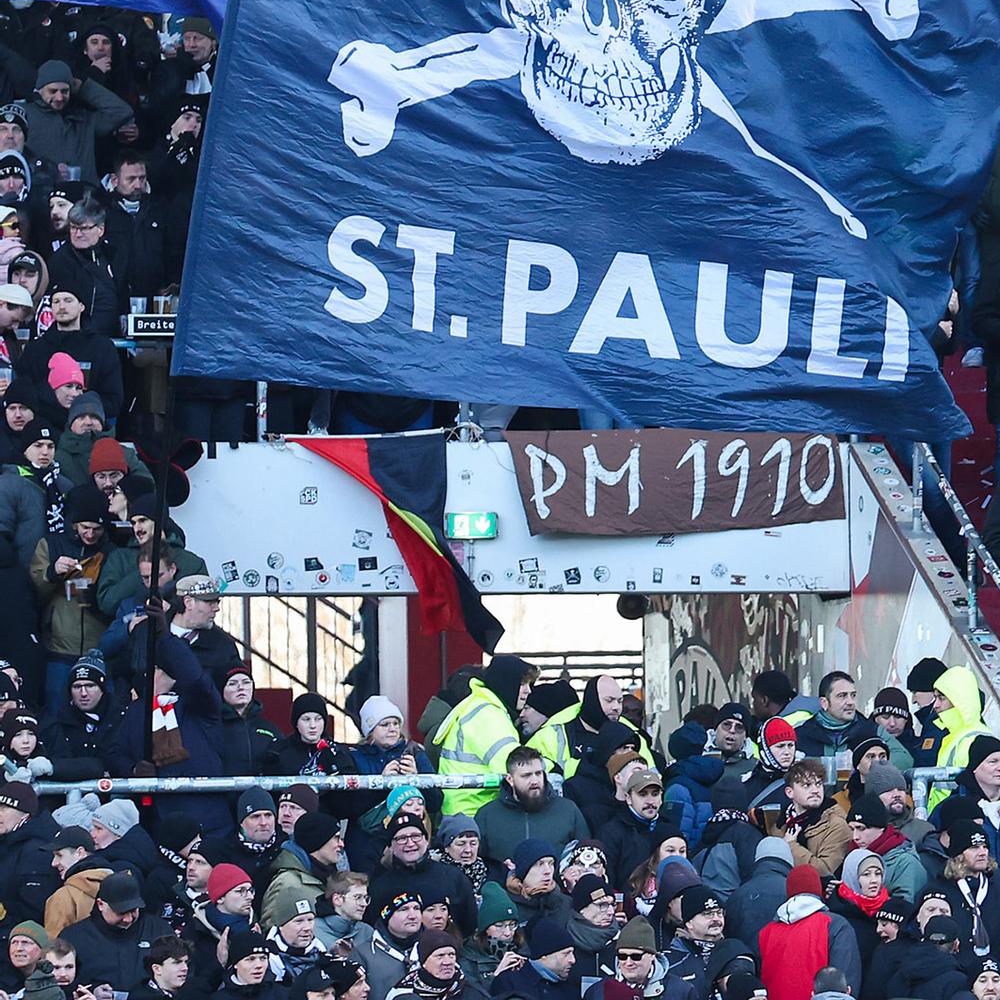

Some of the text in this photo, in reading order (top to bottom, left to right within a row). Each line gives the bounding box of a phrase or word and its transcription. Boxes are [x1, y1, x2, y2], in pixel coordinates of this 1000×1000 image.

[137, 320, 175, 330] Breite
[323, 216, 911, 383] ST. PAULI
[523, 434, 838, 520] PM 1910
